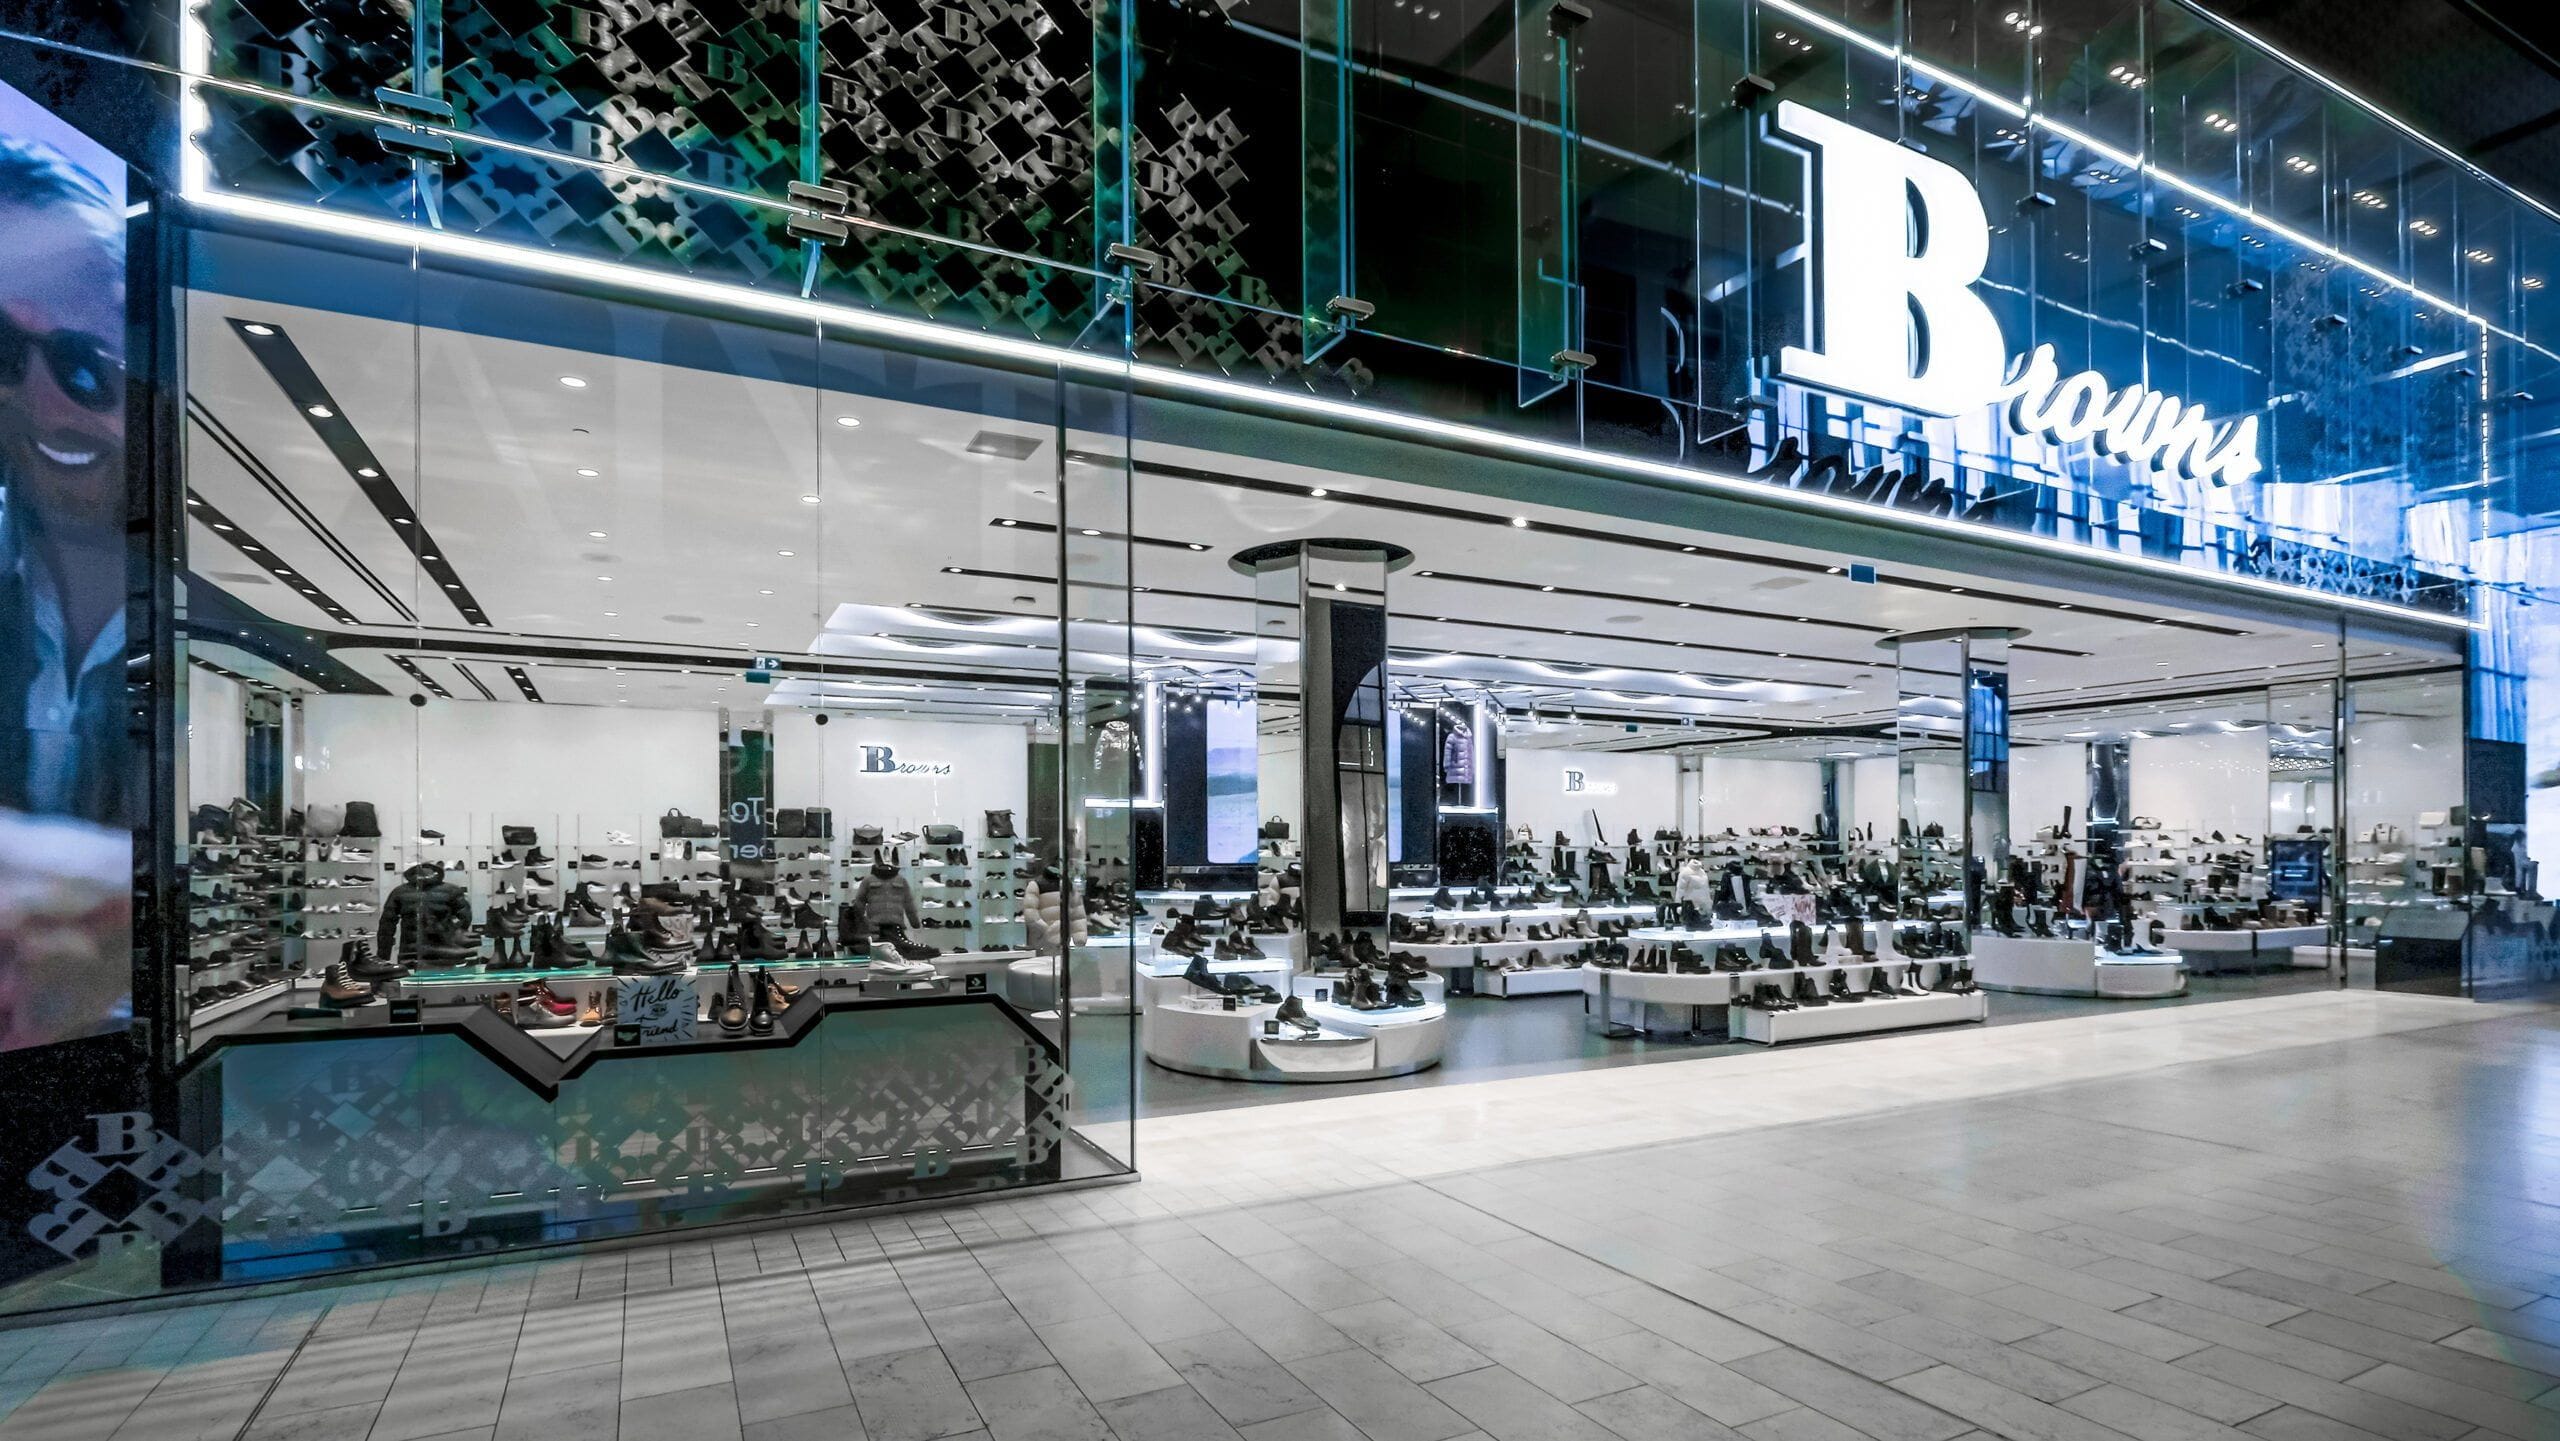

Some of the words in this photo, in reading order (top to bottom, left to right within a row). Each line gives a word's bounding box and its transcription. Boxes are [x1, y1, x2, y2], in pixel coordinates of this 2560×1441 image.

[1776, 99, 2263, 486] Browns
[631, 979, 684, 1012] Hello
[85, 1111, 154, 1158] B
